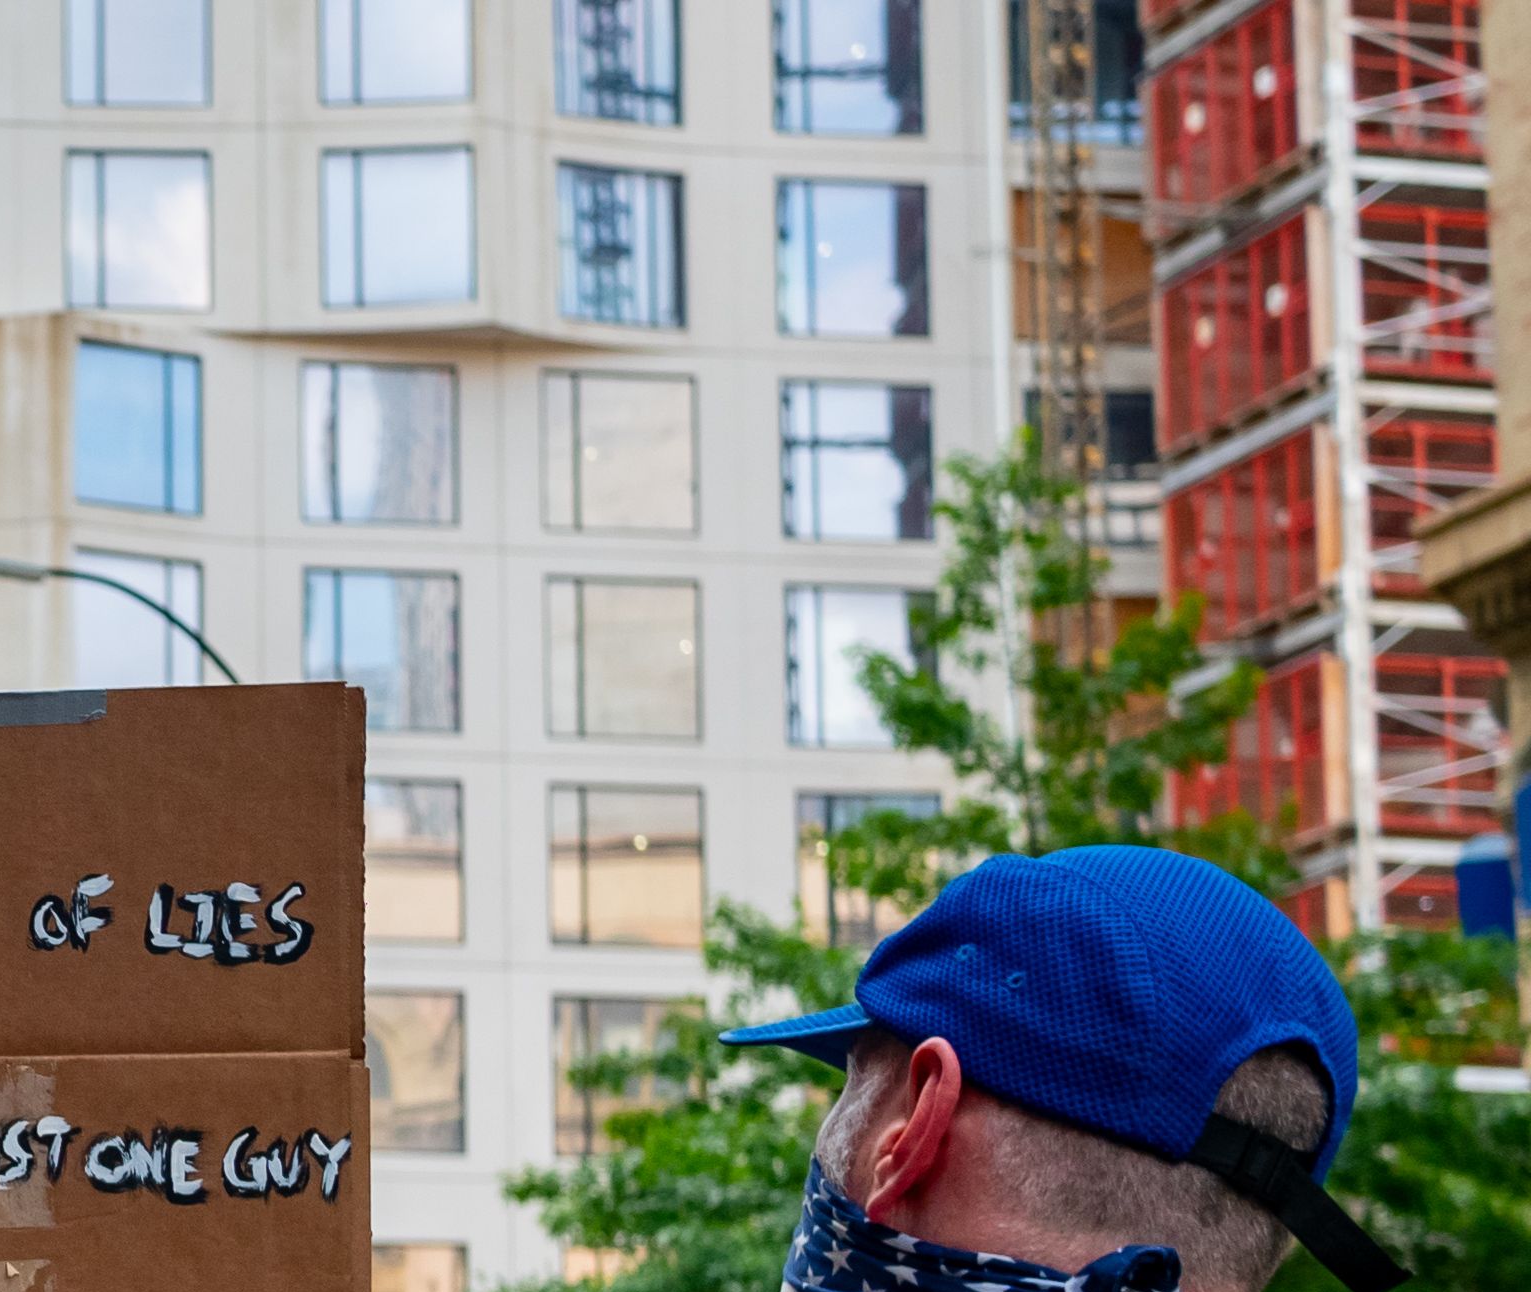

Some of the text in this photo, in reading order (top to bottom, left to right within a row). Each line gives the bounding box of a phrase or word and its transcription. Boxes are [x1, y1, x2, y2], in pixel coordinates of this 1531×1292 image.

[29, 873, 113, 952] OF
[147, 881, 315, 966] LIES
[84, 1123, 208, 1204] ONE
[222, 1126, 351, 1203] GUY
